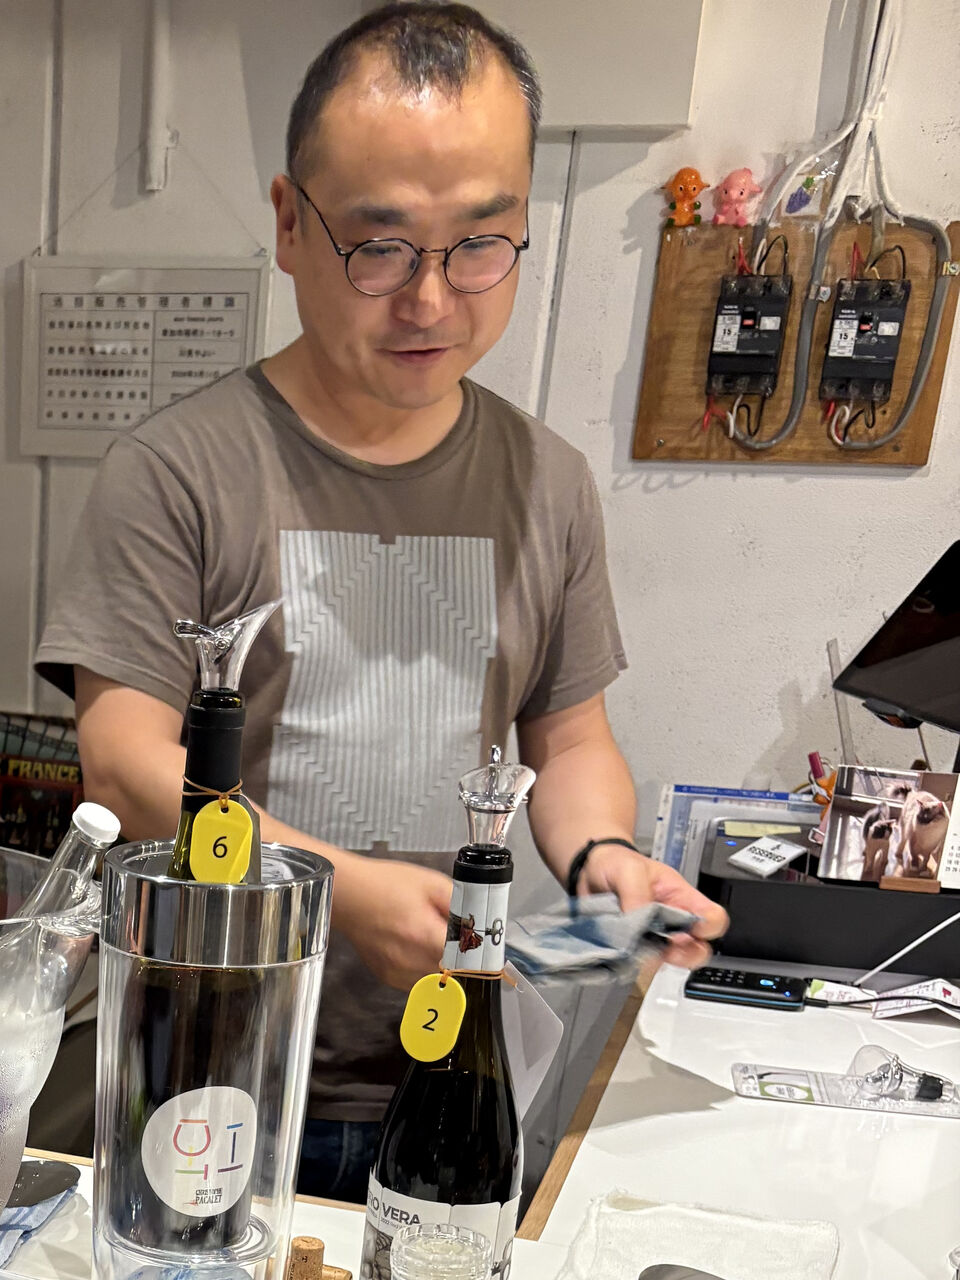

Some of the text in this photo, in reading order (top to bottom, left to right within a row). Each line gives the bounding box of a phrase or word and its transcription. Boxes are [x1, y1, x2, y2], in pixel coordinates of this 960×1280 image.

[7, 758, 81, 784] FRANCE
[212, 836, 228, 858] 6
[421, 1008, 439, 1032] 2
[382, 1202, 420, 1225] VERA
